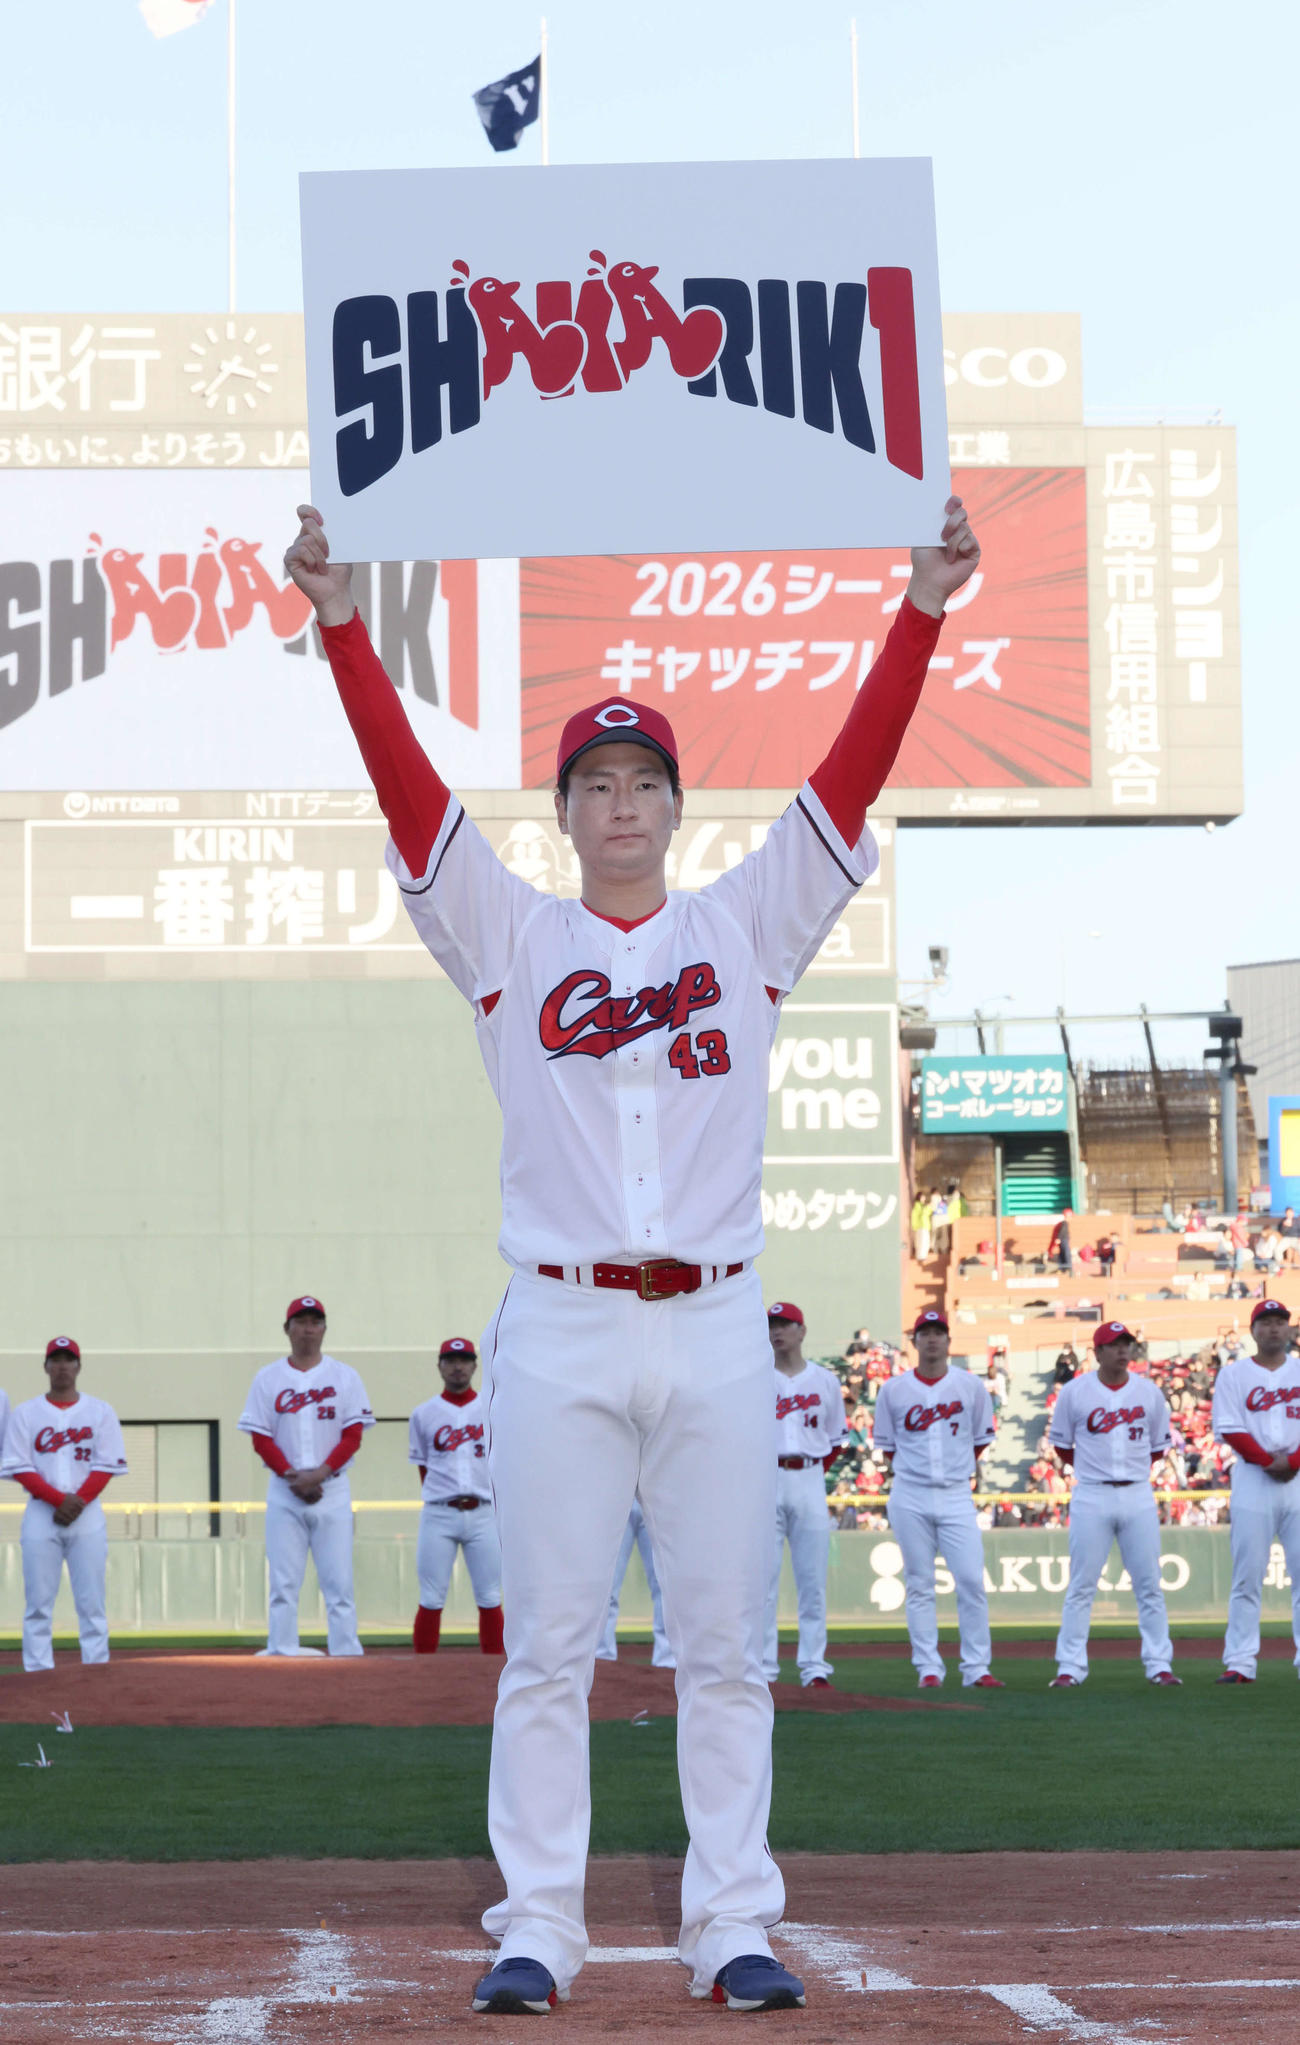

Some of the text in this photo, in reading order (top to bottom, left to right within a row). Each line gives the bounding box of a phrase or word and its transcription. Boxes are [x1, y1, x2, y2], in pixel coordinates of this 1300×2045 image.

[0, 322, 161, 412] 銀行
[1169, 449, 1224, 702] シシンヨー
[1102, 447, 1161, 806] 広島市信用組合
[246, 792, 374, 817] NTTデータ
[173, 828, 294, 861] KIRIN
[71, 866, 399, 945] 一番搾り
[539, 962, 721, 1060] Carp
[668, 1028, 731, 1079] 43
[961, 1068, 1064, 1096] マツオカ
[781, 1087, 881, 1129] me
[925, 1097, 1065, 1119] コーポレーション
[275, 1386, 337, 1414] Carp
[776, 1394, 821, 1420] arp
[904, 1401, 964, 1432] Carp
[949, 1422, 959, 1437] 7
[1087, 1406, 1146, 1434] Carp
[34, 1426, 94, 1452] Carp
[1128, 1427, 1149, 1441] 37
